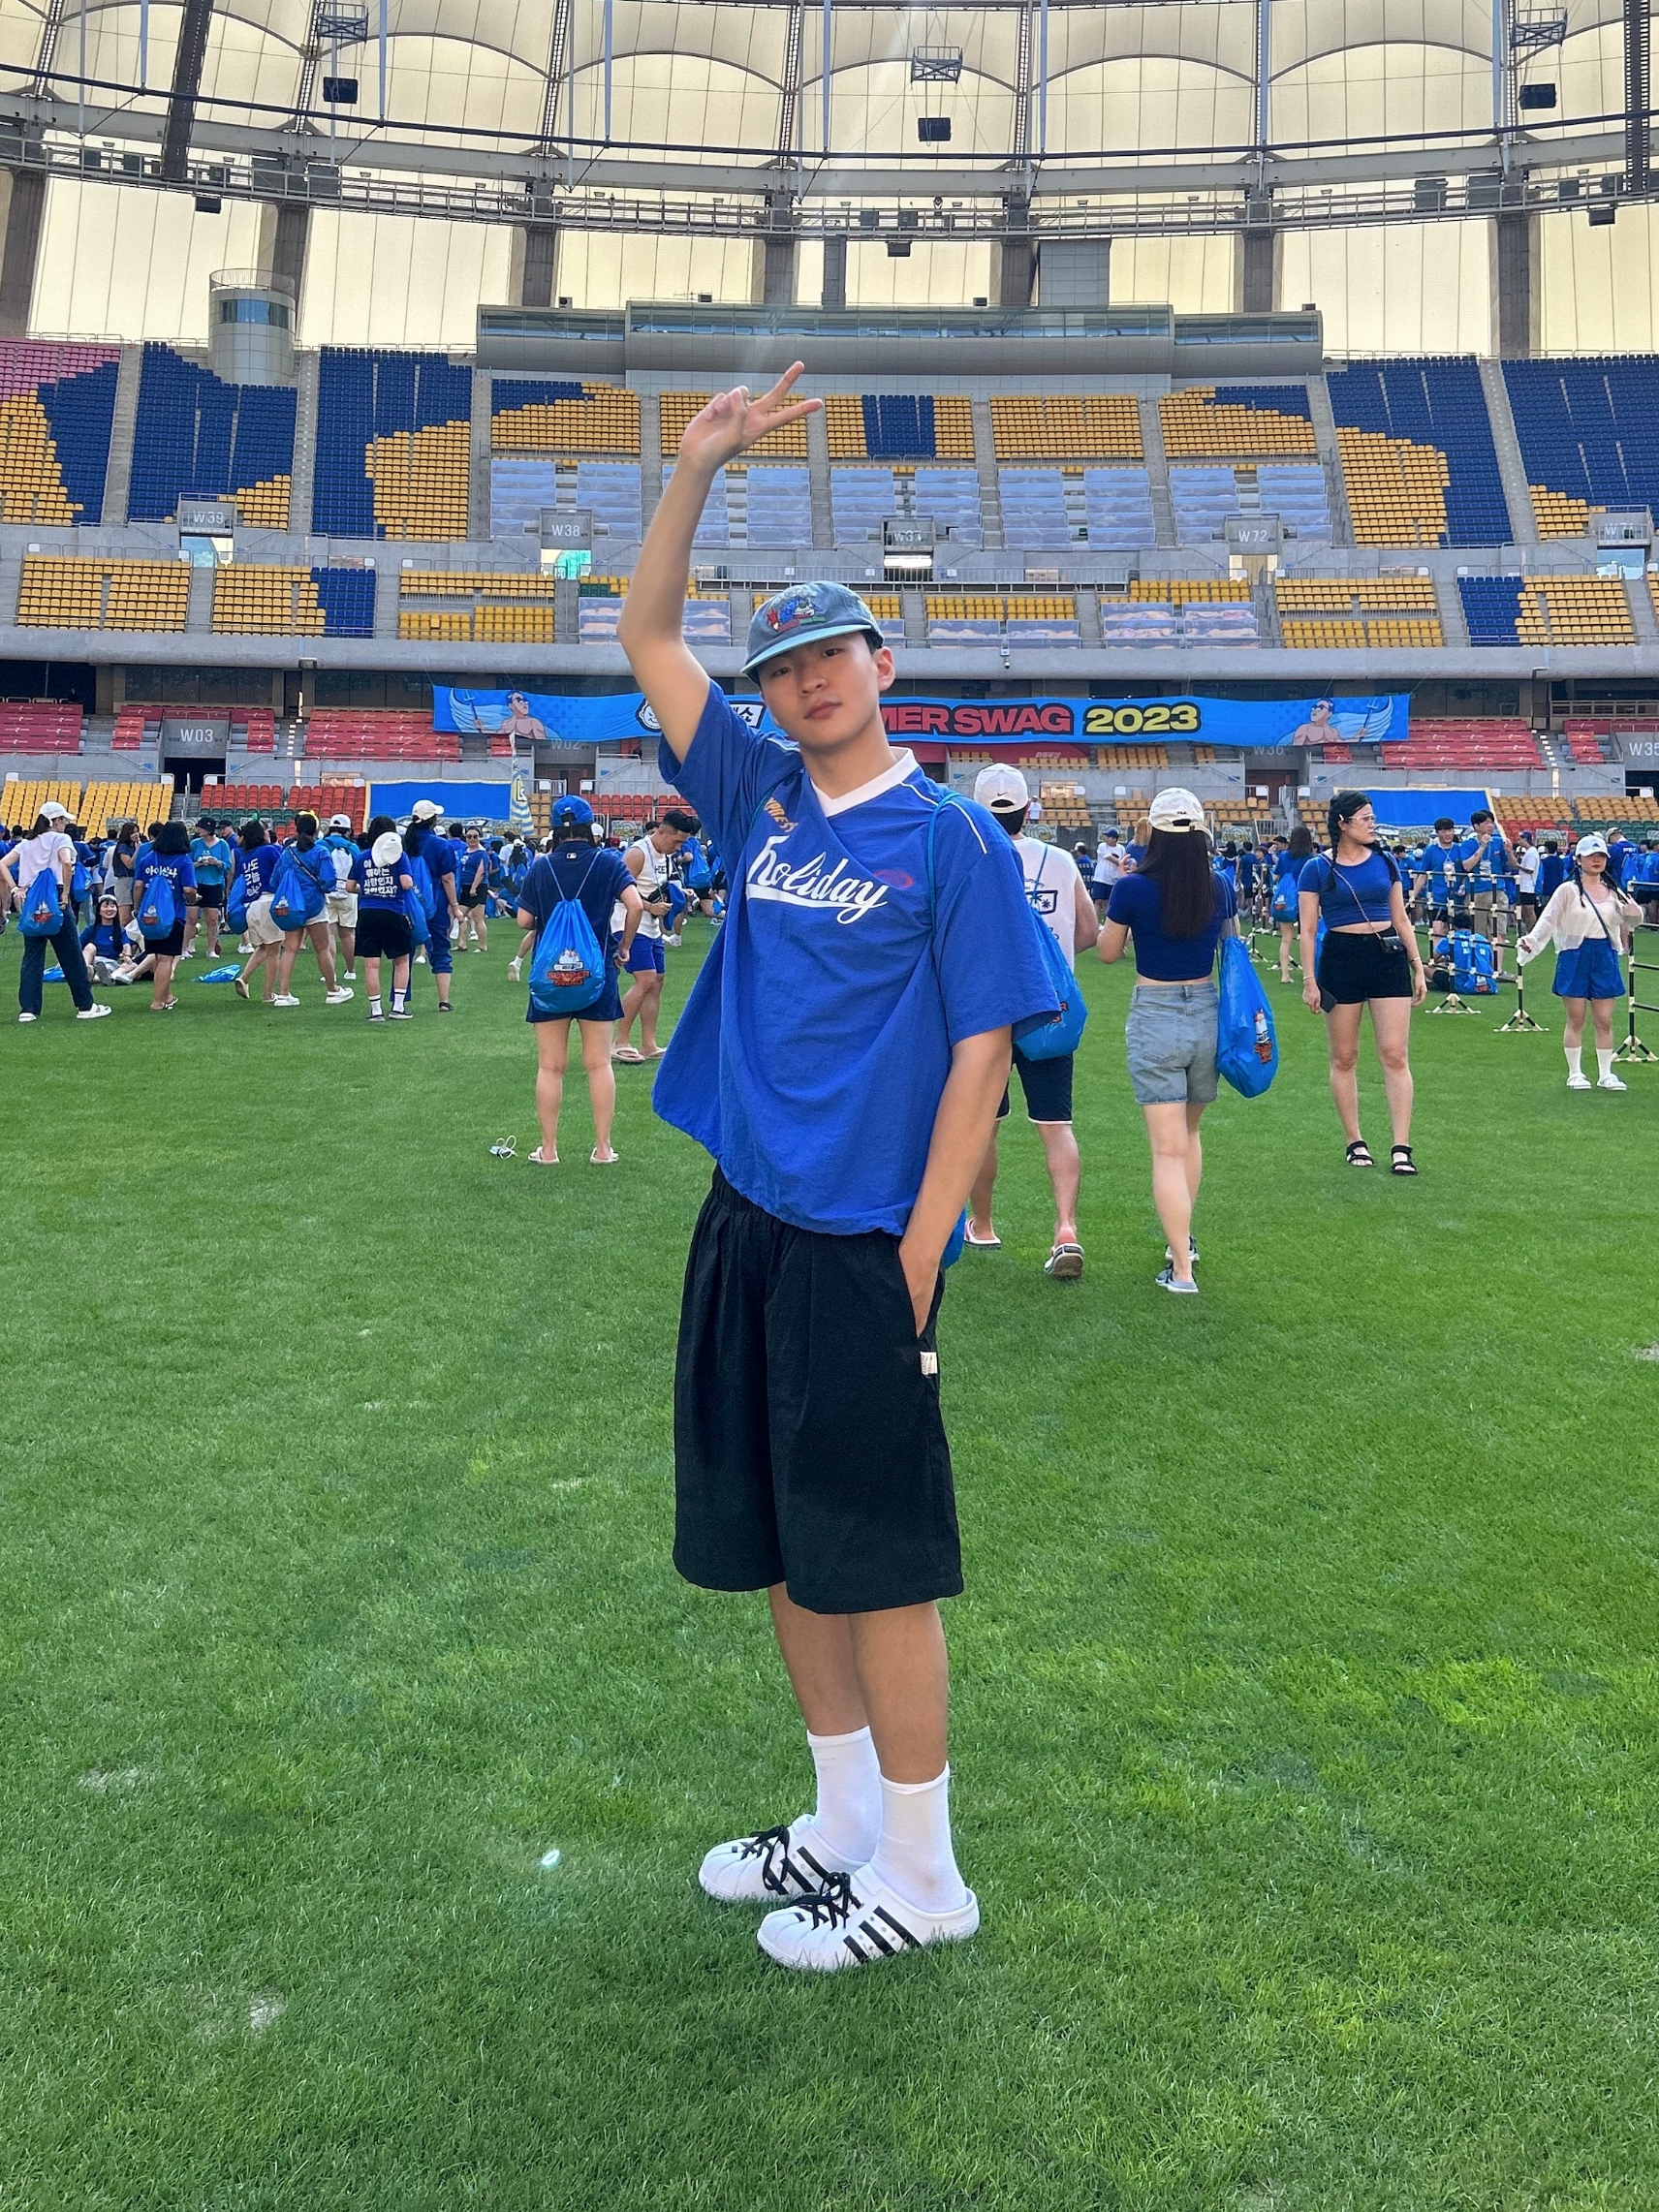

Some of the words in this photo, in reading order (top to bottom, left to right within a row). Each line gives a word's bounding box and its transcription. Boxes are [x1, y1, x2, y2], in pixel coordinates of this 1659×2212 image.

[194, 511, 224, 524] W39
[551, 524, 580, 538] W38
[1237, 529, 1268, 543] W72
[879, 705, 950, 733] MER
[954, 706, 1071, 733] SWAG
[1085, 704, 1199, 733] 2023
[180, 728, 213, 743] W03
